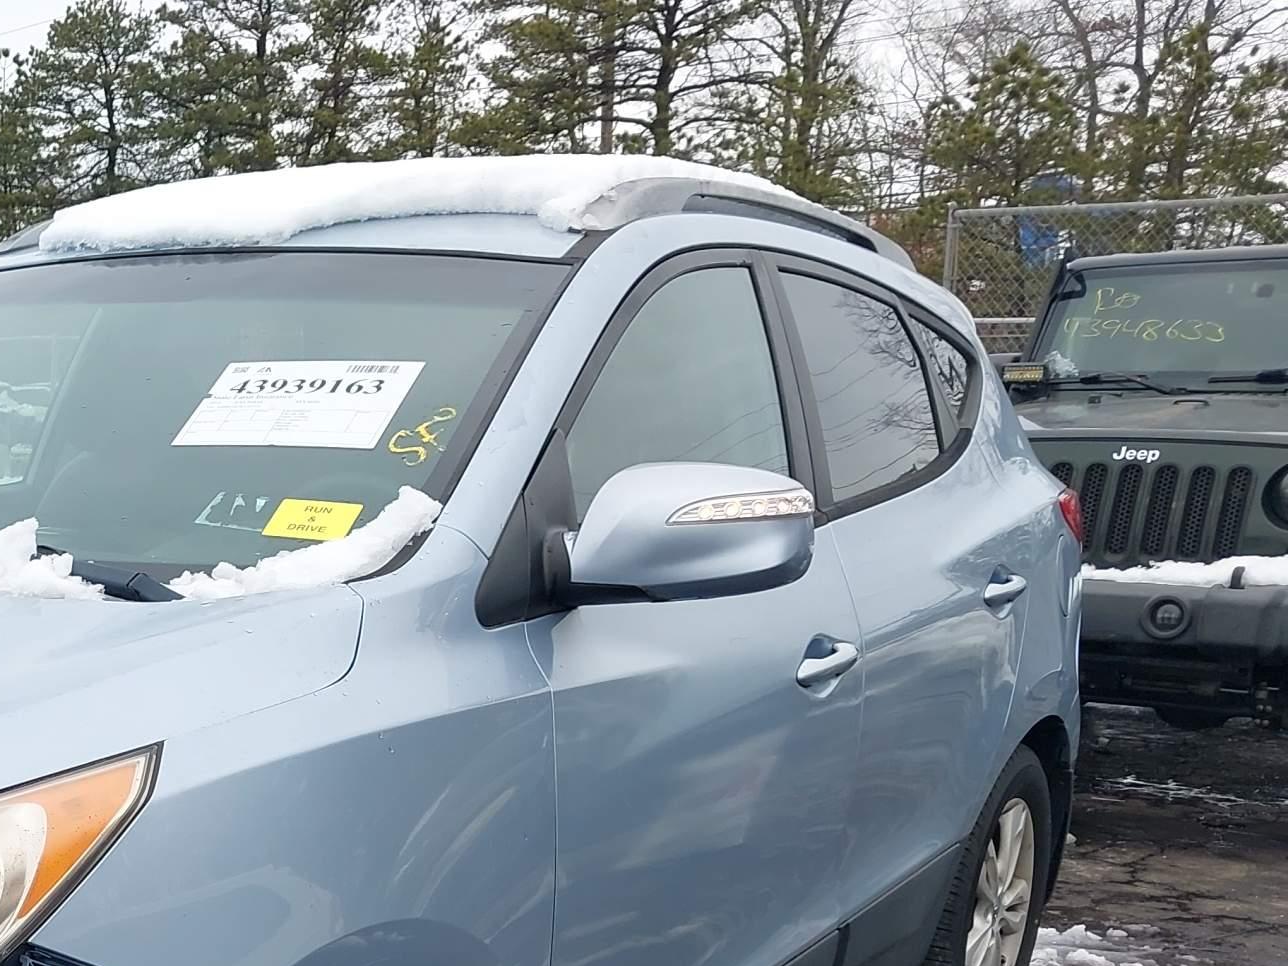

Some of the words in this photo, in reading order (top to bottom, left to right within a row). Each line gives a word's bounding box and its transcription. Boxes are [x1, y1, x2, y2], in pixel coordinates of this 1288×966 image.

[229, 378, 385, 395] 43939163
[1112, 446, 1160, 463] Jeep
[304, 505, 333, 514] RUN
[286, 523, 328, 533] DRIVE
